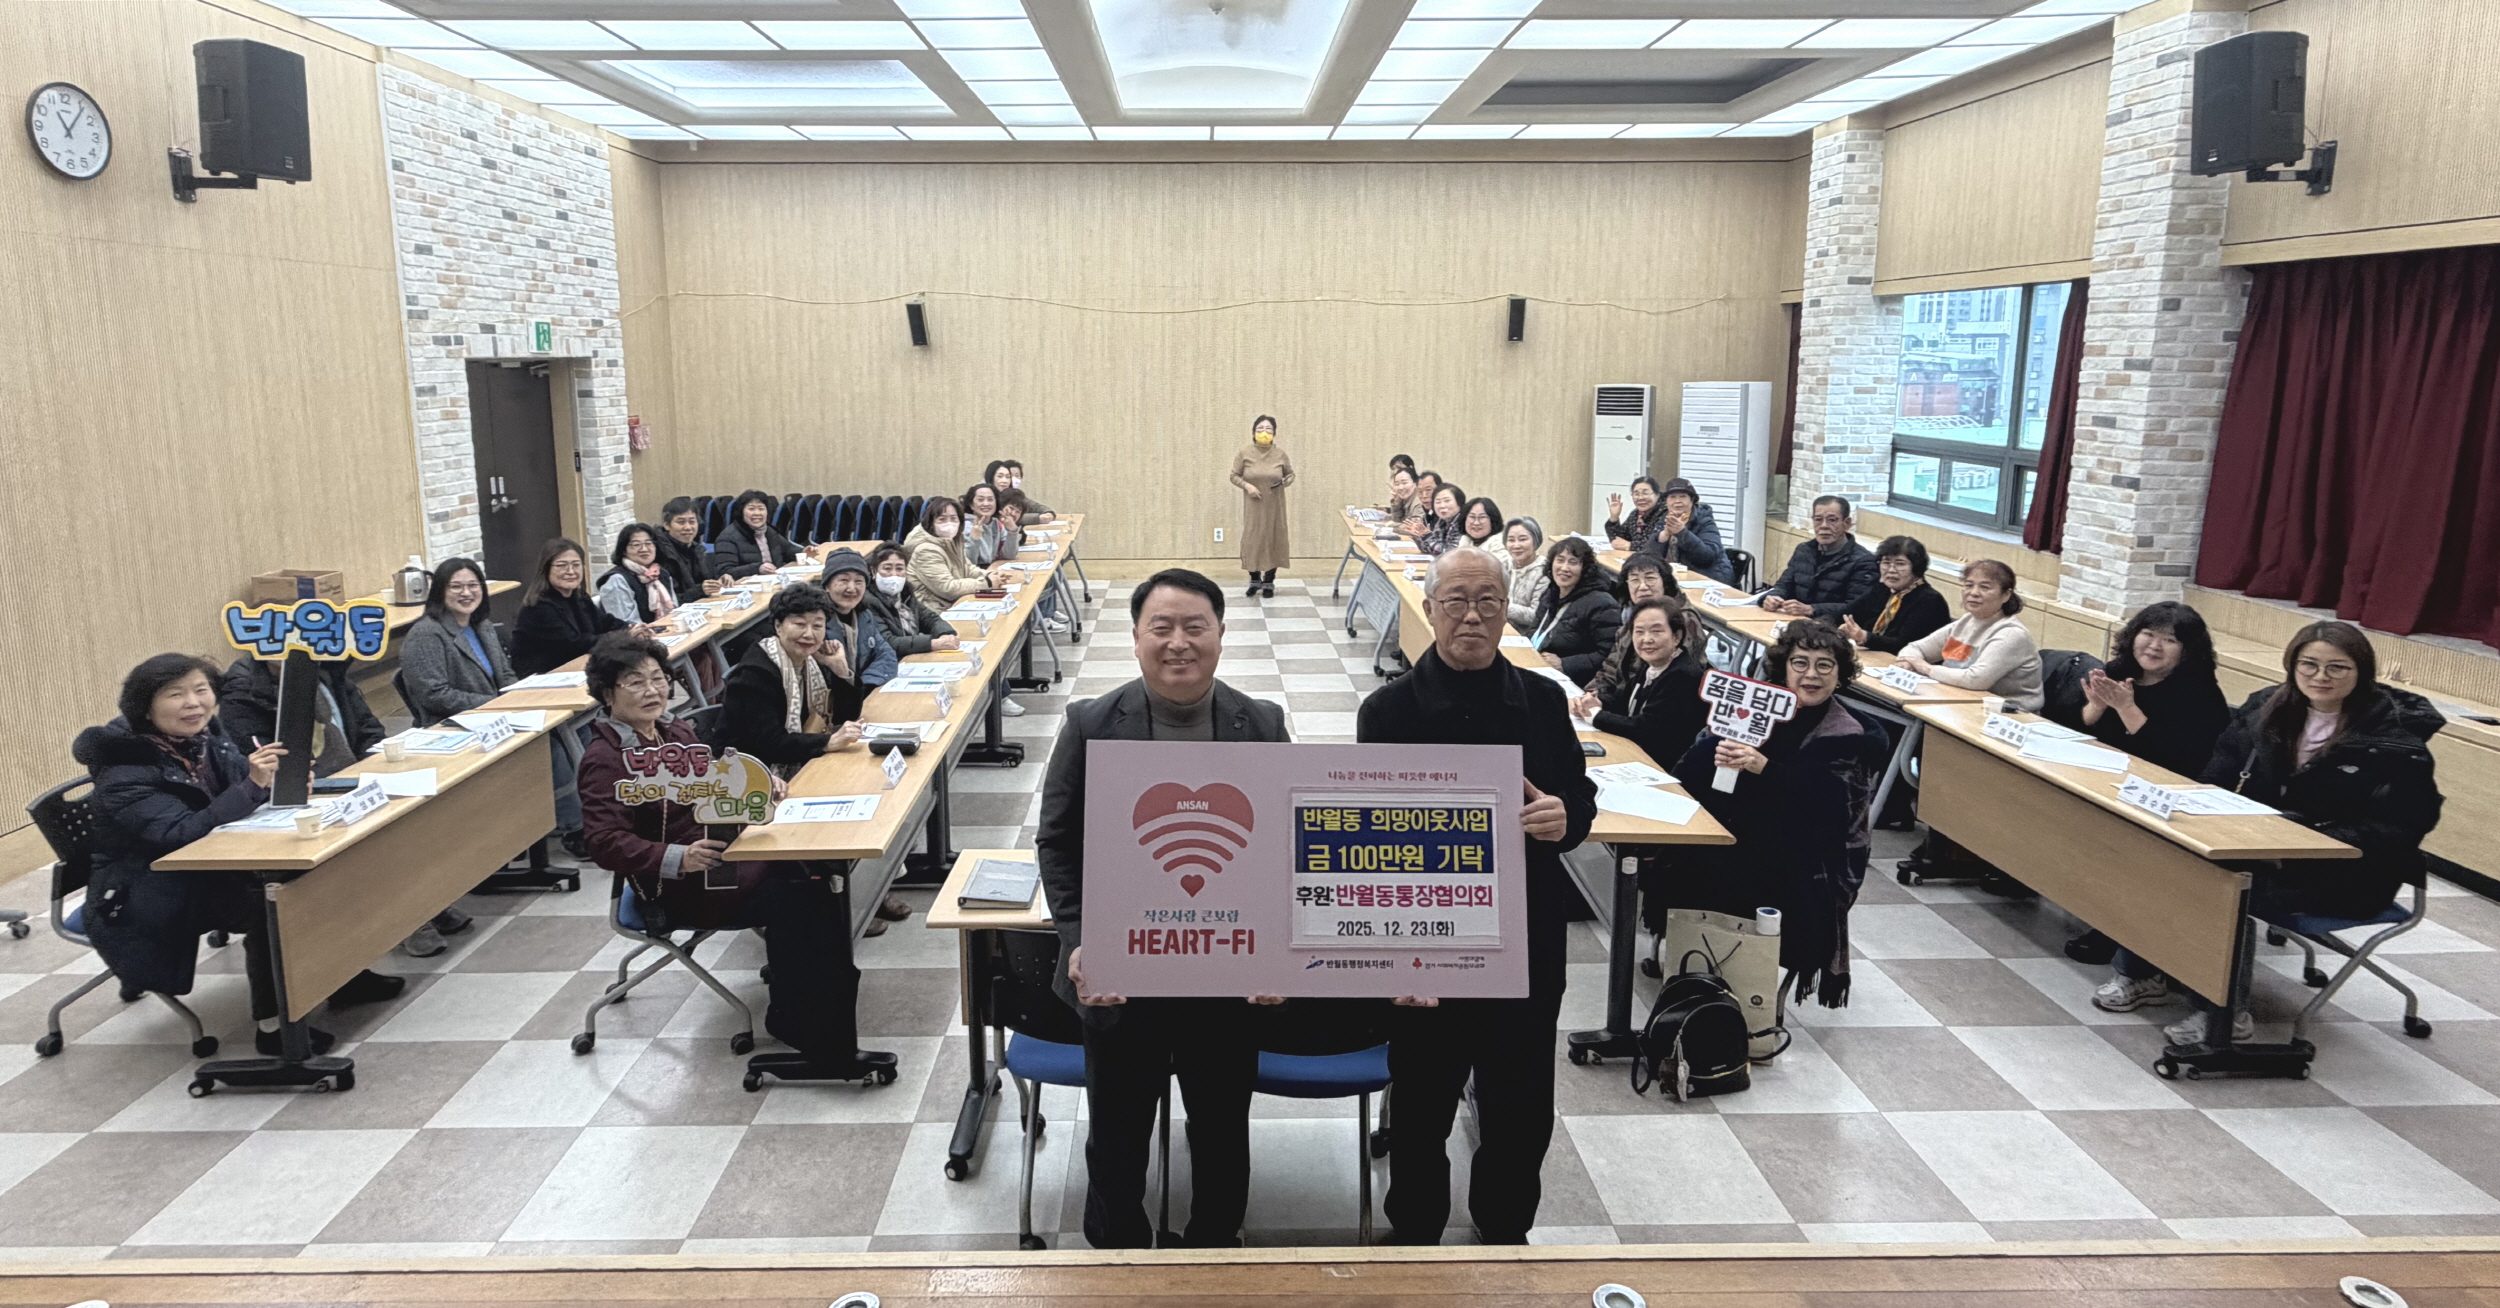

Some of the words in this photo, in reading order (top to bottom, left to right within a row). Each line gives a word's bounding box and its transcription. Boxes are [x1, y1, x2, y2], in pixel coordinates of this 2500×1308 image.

[47, 93, 56, 105] 11
[59, 92, 71, 105] 12
[36, 104, 47, 117] 10
[34, 119, 44, 131] 9
[86, 115, 95, 127] 2
[40, 137, 49, 149] 8
[91, 132, 100, 143] 3
[52, 151, 62, 163] 7
[88, 148, 96, 158] 4
[66, 158, 75, 170] 6
[80, 157, 89, 169] 5
[226, 601, 385, 656] 반월동
[1706, 674, 1748, 705] 꿈을
[1750, 686, 1792, 718] 담다
[626, 744, 711, 777] 반월동
[1398, 772, 1427, 781] 따뜻한
[619, 783, 666, 803] 달이
[714, 790, 768, 822] 마을
[1176, 800, 1209, 811] ANSAN
[1303, 808, 1361, 832] 반월동
[1371, 808, 1488, 833] 희망이웃사업
[1307, 844, 1331, 871] 금
[1337, 844, 1425, 872] 100만원
[1437, 844, 1485, 872] 기탁
[1143, 909, 1197, 923] 작은사랑
[1201, 909, 1239, 923] 큰보람
[1337, 921, 1376, 936] 2025.
[1384, 921, 1404, 936] 12.
[1128, 928, 1255, 955] HEART-FI
[1326, 959, 1394, 969] 반월동행정복지센터
